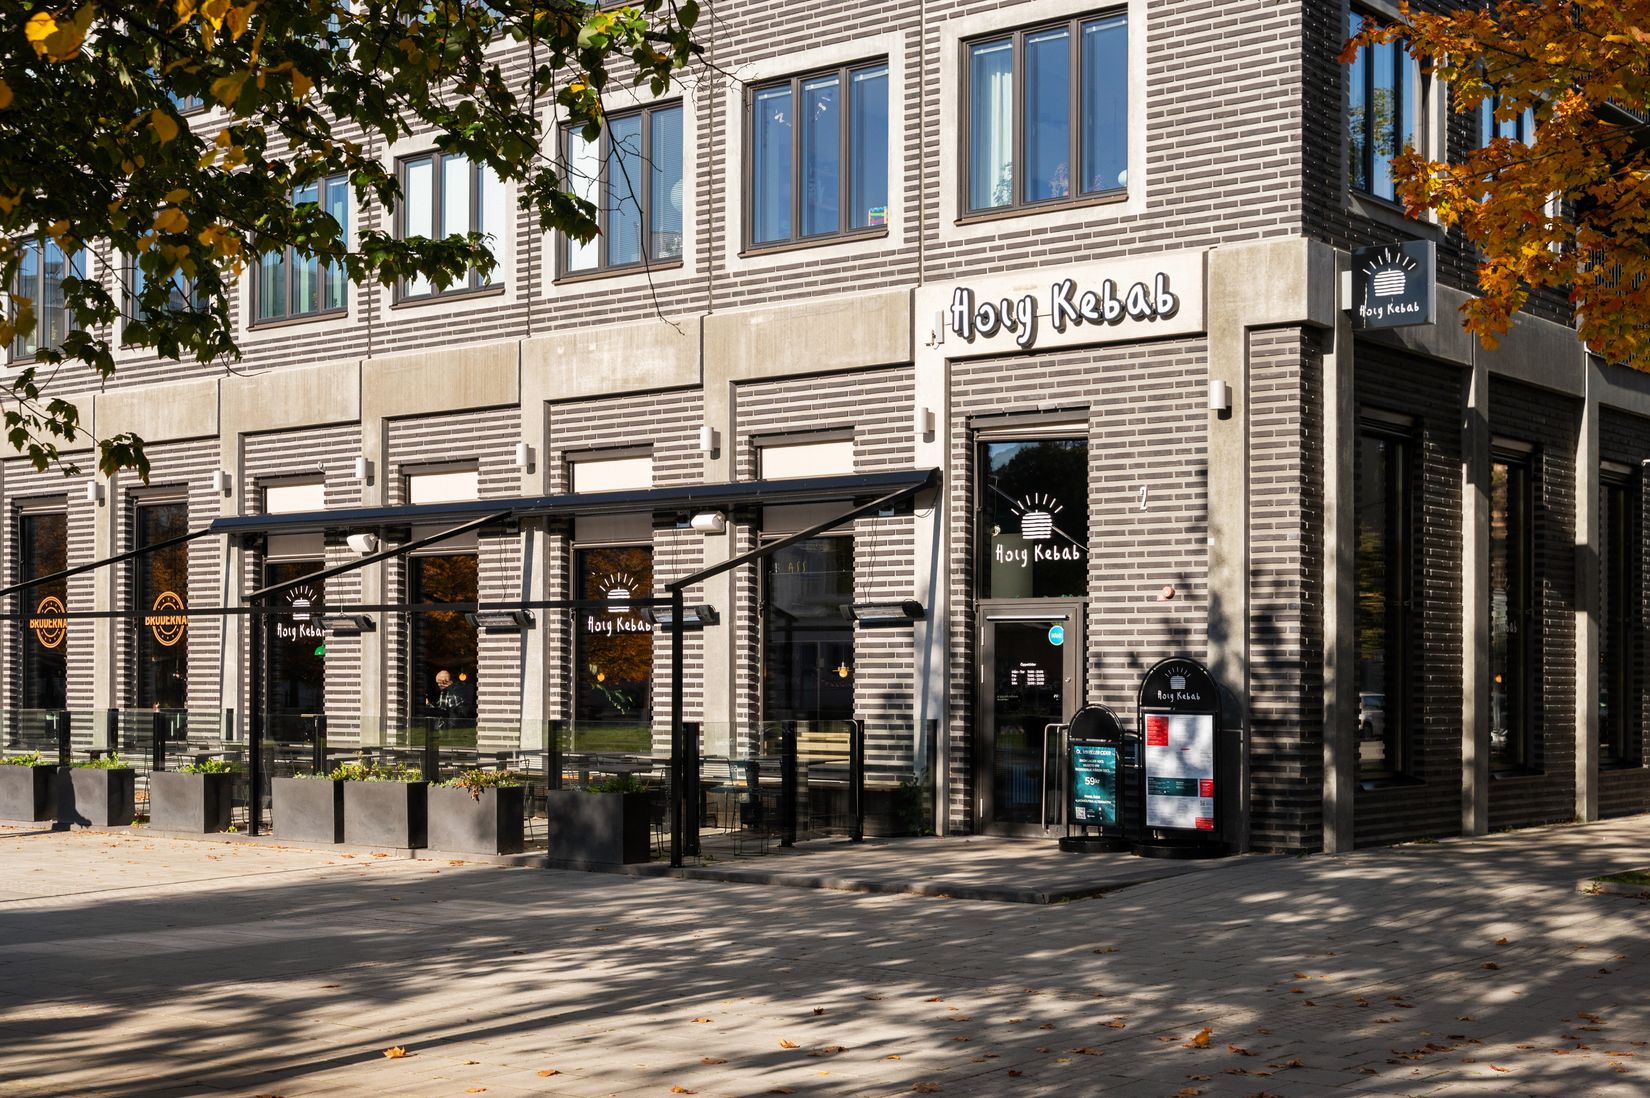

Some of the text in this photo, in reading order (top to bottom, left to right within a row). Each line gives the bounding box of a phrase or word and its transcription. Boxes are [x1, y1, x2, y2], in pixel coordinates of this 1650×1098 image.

[1052, 272, 1180, 333] Kebab
[1387, 301, 1420, 315] Kebab
[1034, 543, 1080, 562] Kebab
[1176, 691, 1200, 701] Kebab
